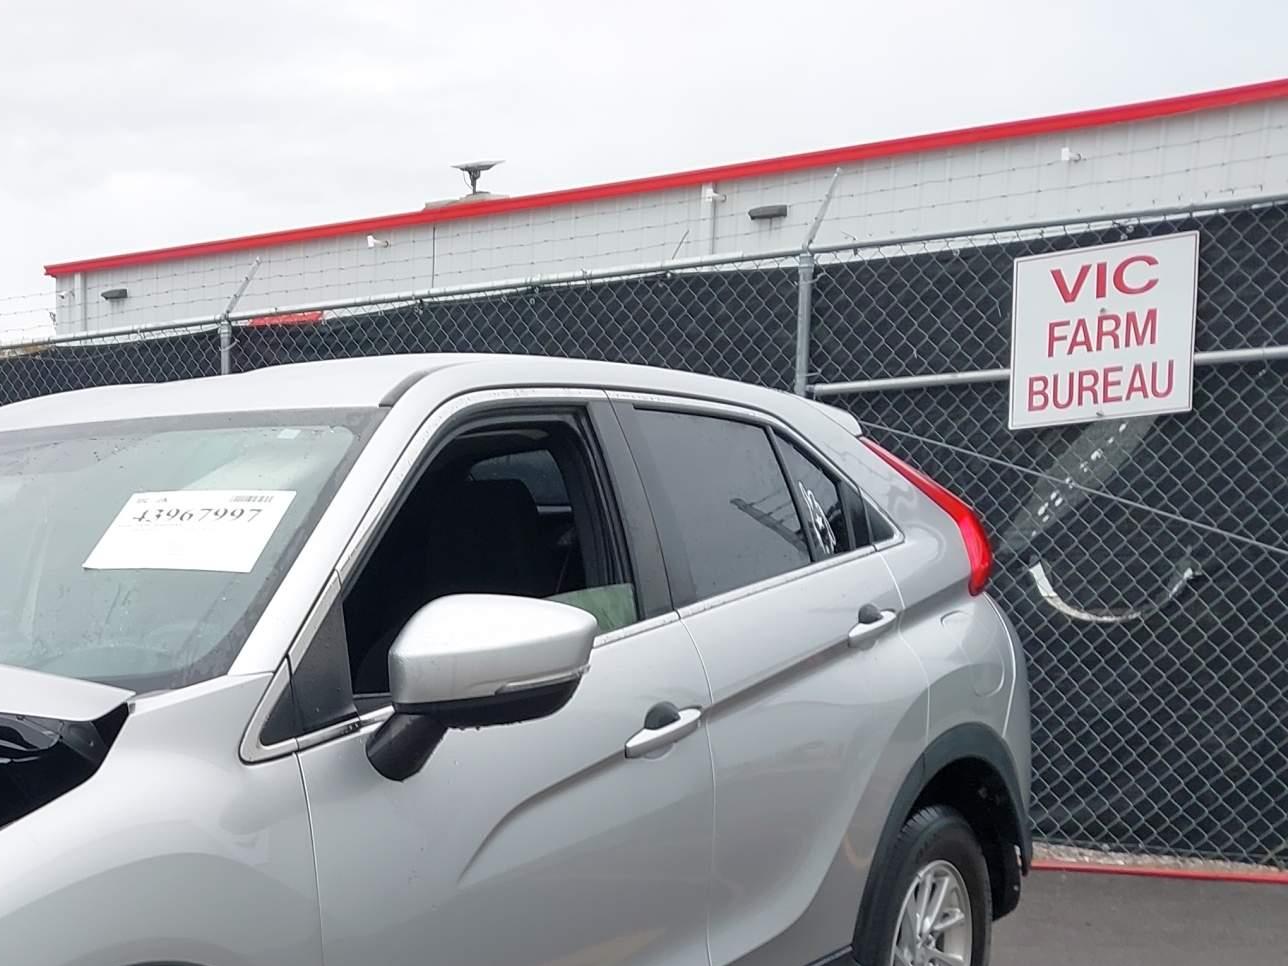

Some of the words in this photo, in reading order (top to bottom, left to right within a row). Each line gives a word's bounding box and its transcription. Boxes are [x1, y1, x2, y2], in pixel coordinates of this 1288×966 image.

[1050, 255, 1160, 304] VIC
[1047, 308, 1158, 358] FARM
[1027, 359, 1175, 412] BUREAU
[132, 508, 263, 522] 43967997
